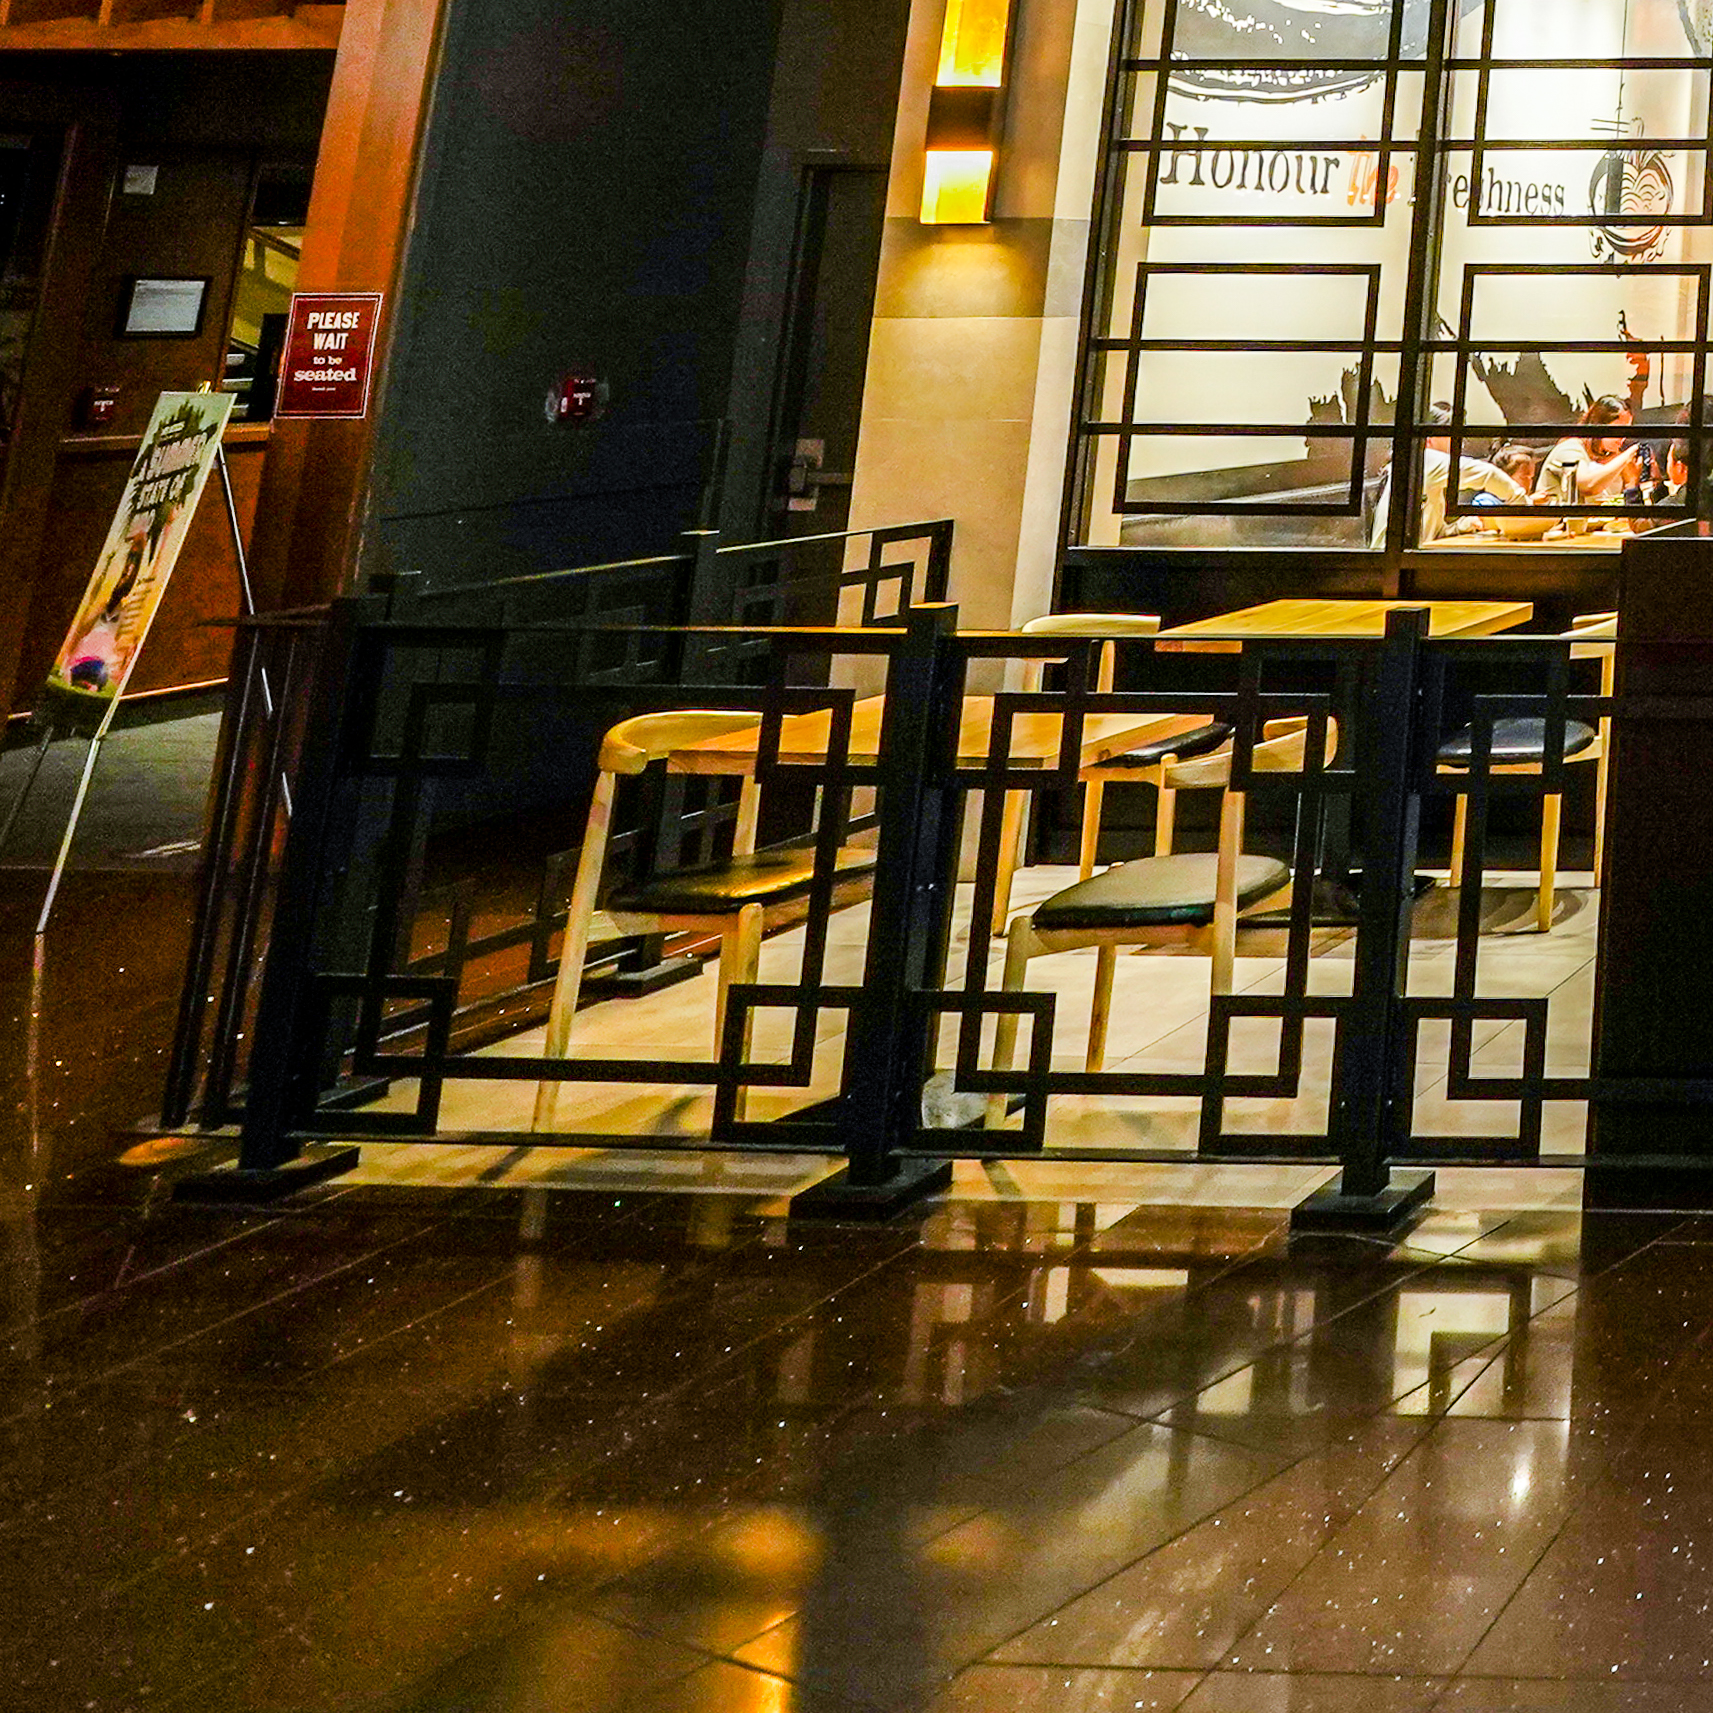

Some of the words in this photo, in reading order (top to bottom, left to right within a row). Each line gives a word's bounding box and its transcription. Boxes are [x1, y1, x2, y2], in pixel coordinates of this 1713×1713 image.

[1160, 122, 1340, 195] Honour
[1407, 129, 1565, 216] ehness
[306, 312, 360, 329] PLEASE
[313, 333, 349, 350] WAIT
[313, 356, 325, 365] to
[328, 356, 342, 365] be
[294, 368, 357, 382] seated
